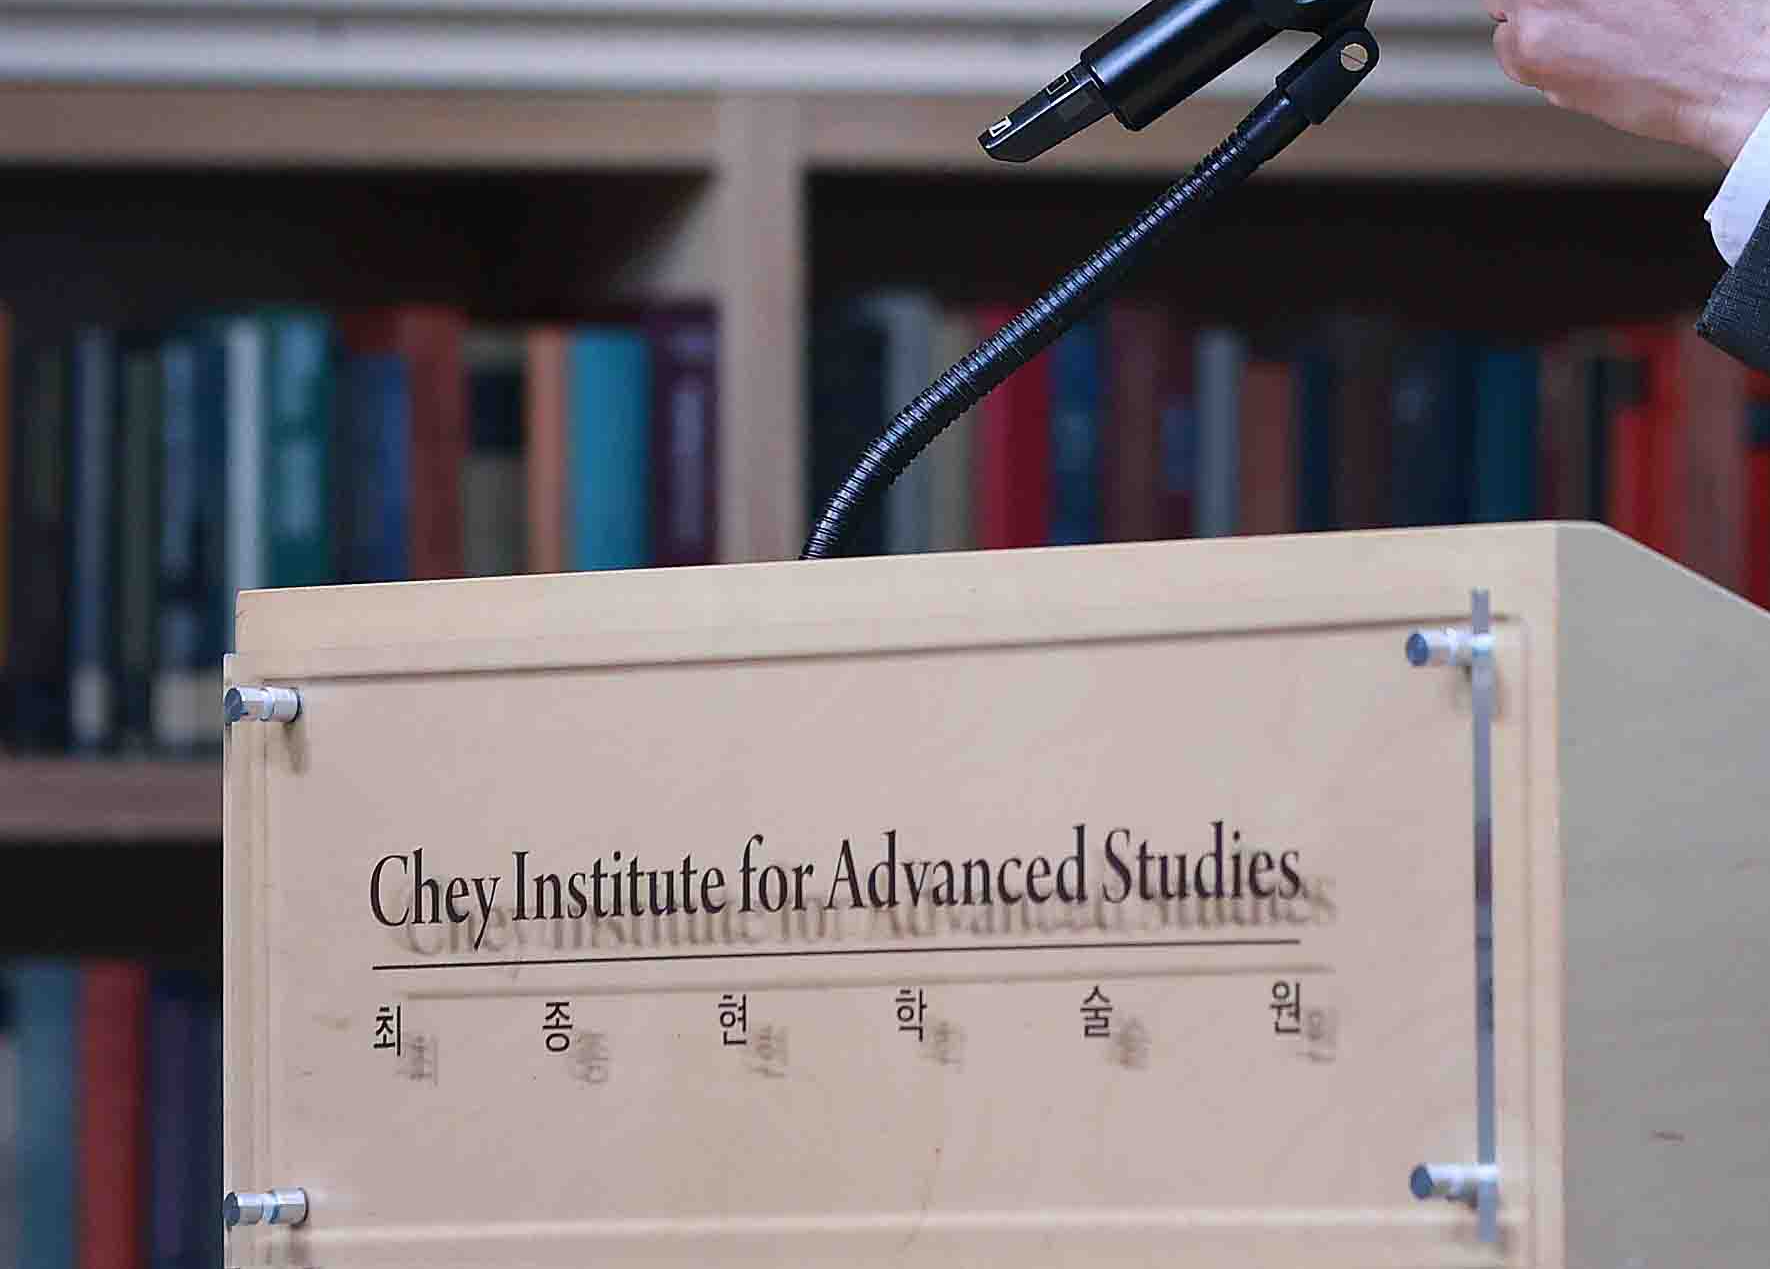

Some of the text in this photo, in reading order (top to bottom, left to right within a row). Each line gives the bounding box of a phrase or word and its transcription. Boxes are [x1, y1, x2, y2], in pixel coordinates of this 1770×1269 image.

[368, 819, 1302, 951] Chey Institute for Advanced Studies
